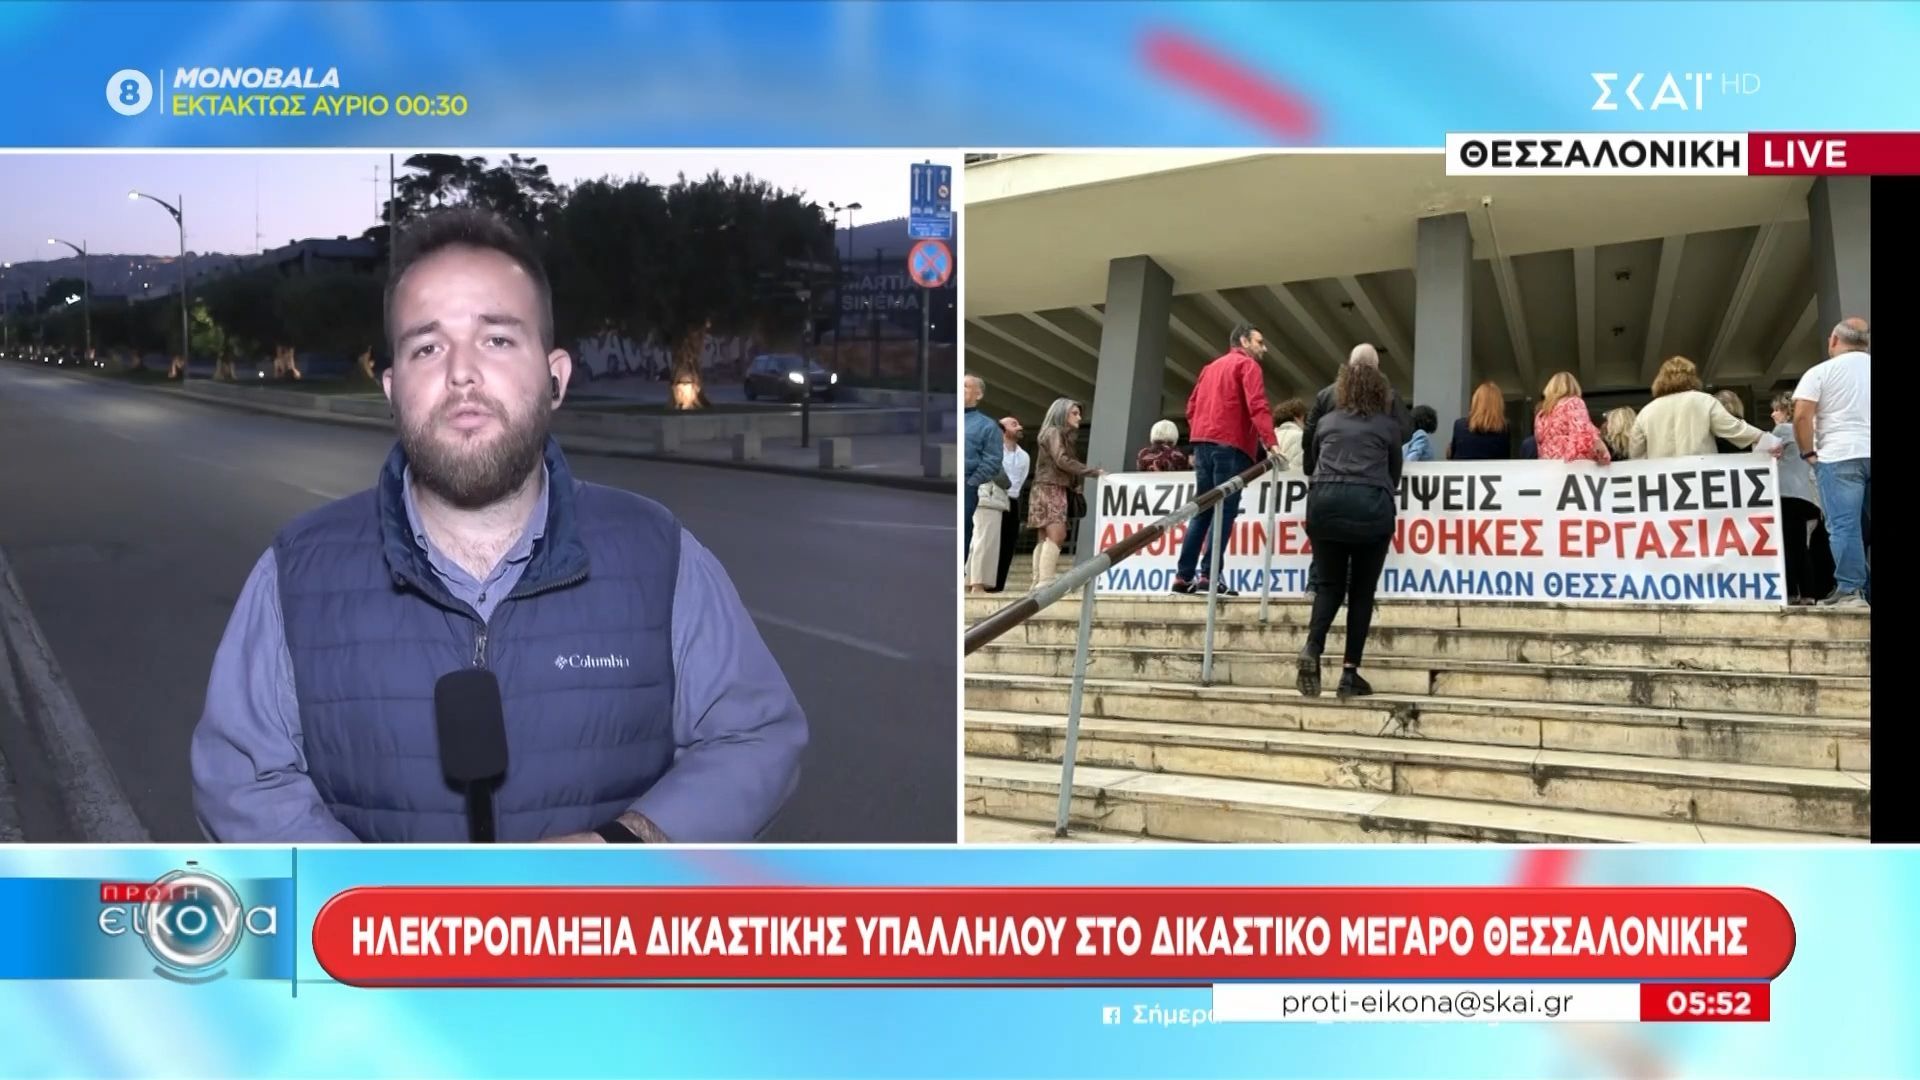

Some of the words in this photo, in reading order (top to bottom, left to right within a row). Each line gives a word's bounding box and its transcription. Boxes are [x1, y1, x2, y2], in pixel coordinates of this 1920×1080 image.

[1556, 468, 1774, 513] ΑΥΞΗΣΕΙΣ
[1559, 517, 1778, 559] ΕΡΓΑΣΙΑΣ
[1384, 568, 1534, 597] ΠΑΛΛΗΛΩΝ
[1544, 571, 1782, 600] ΘΕΣΣΑΛΟΝΙΚΗΣ
